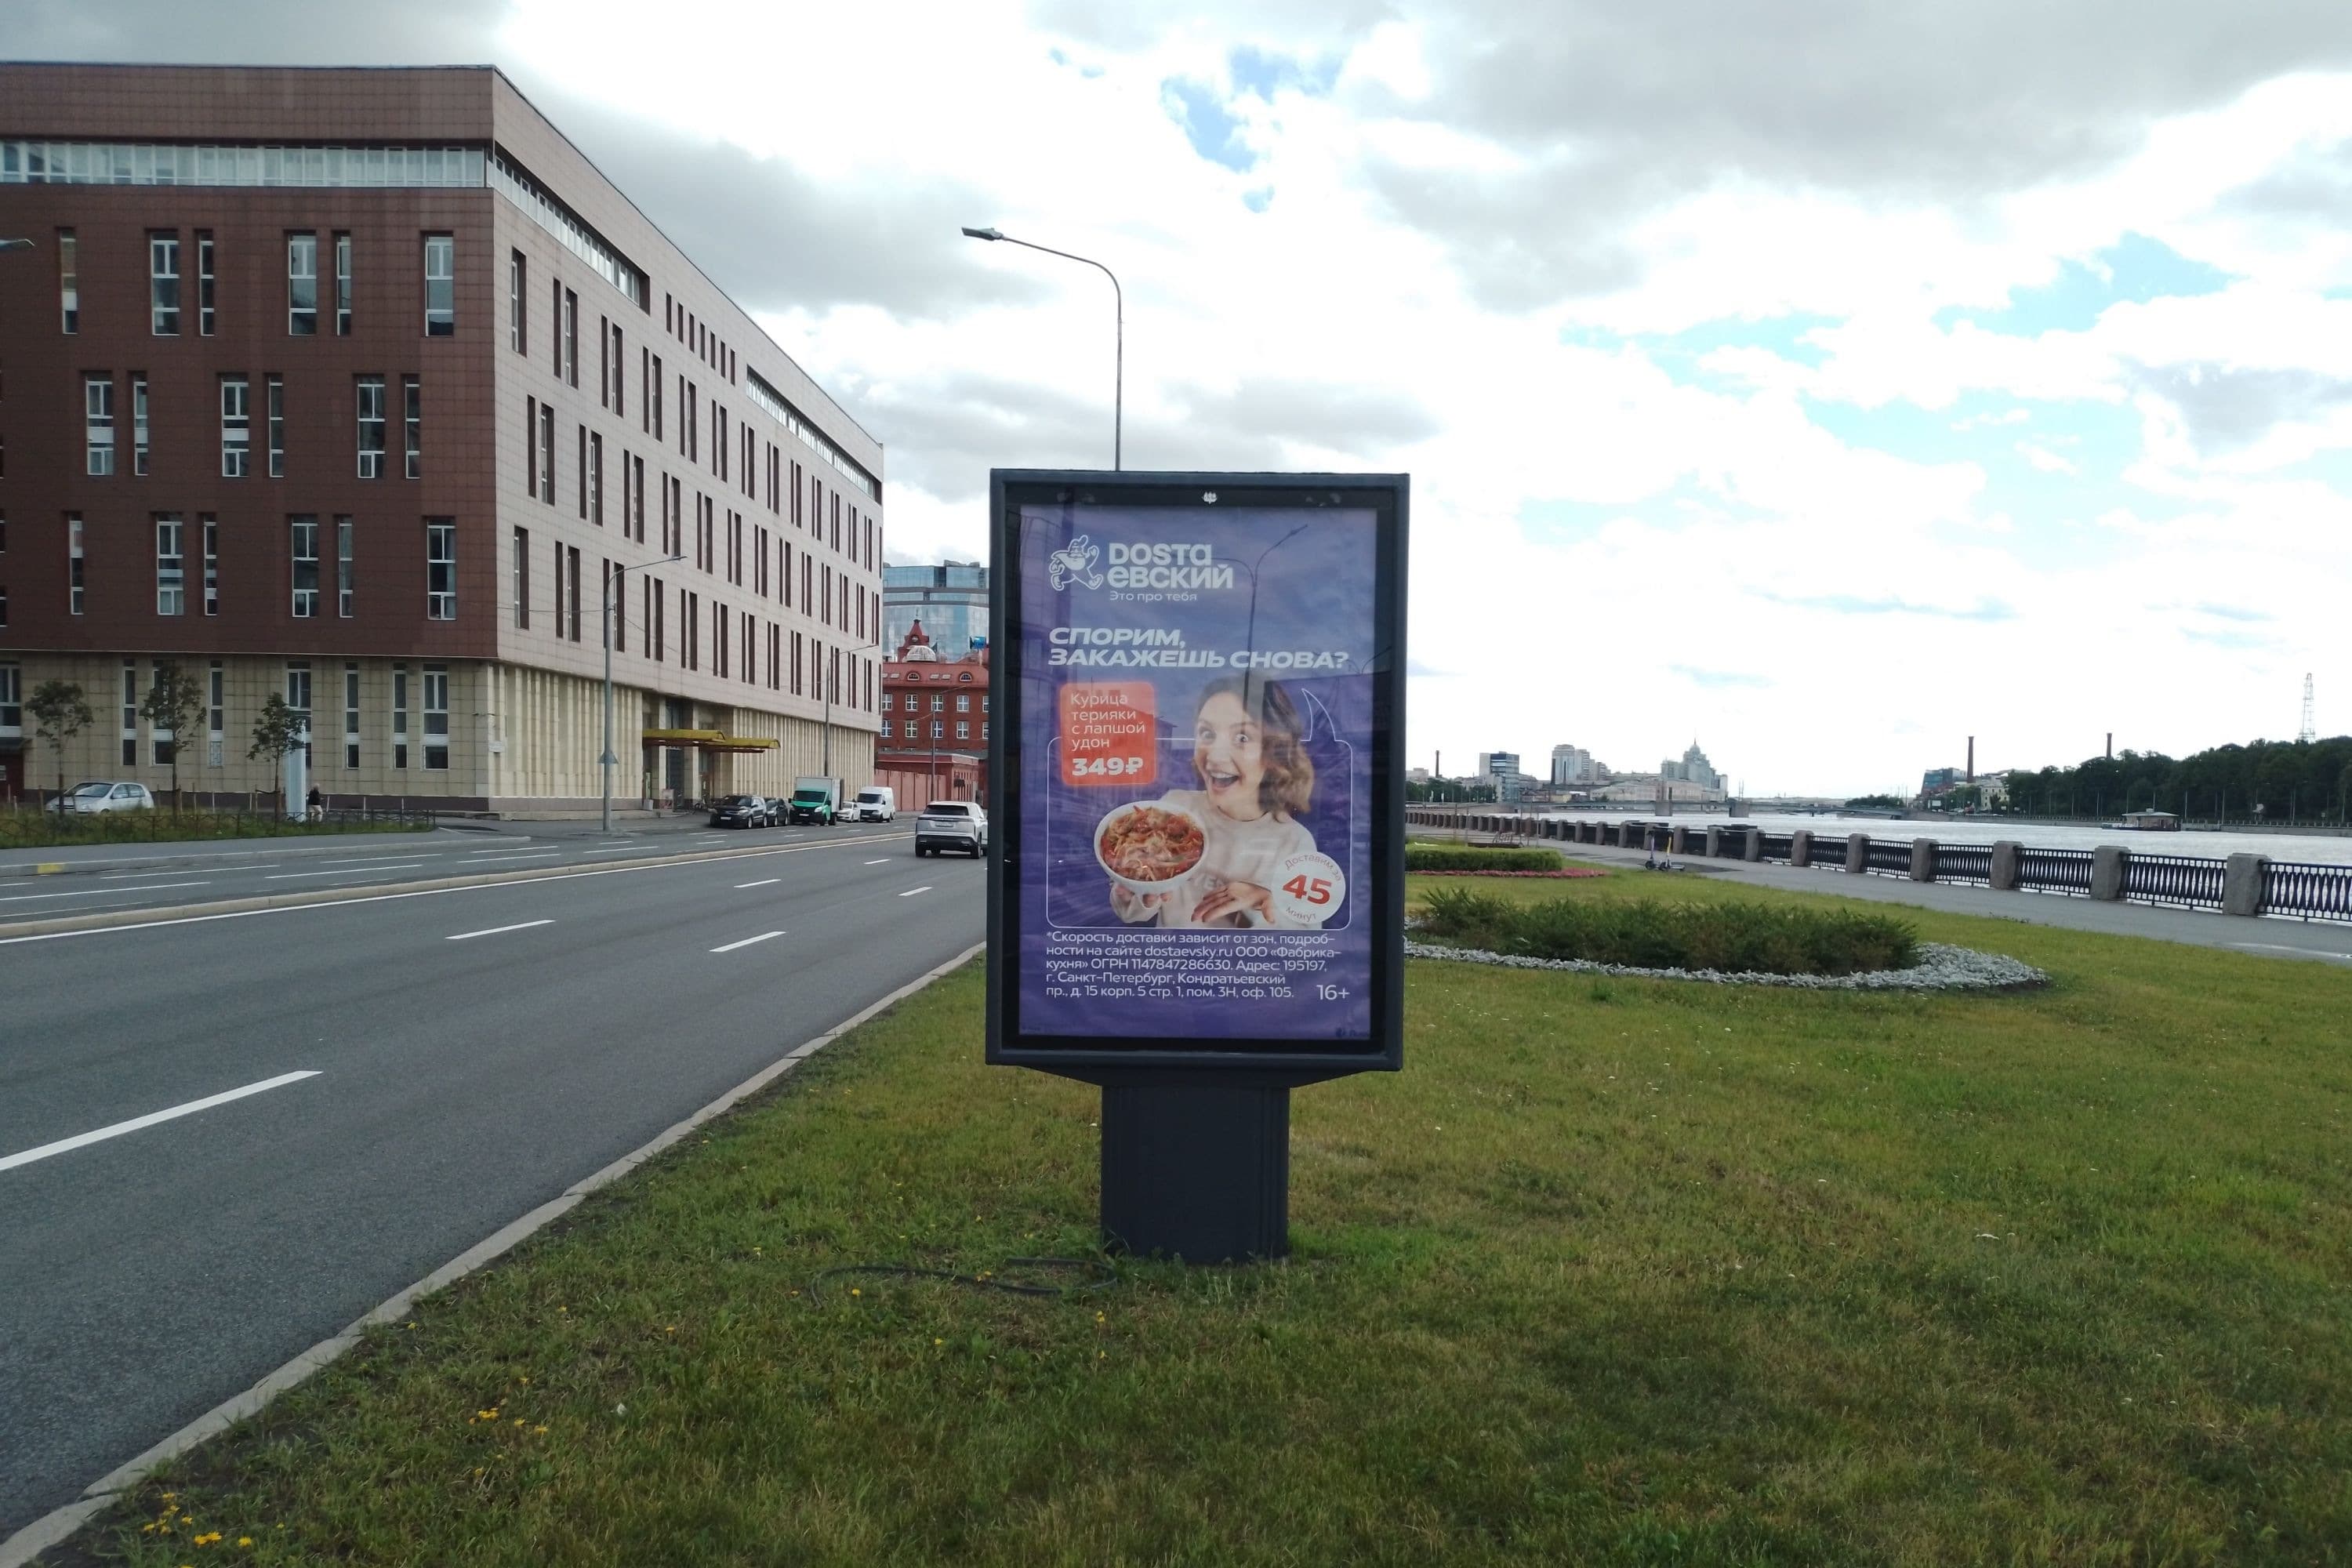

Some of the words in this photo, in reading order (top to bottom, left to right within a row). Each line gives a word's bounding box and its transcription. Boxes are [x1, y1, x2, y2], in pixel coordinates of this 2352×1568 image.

[1109, 591, 1134, 601] Это
[1137, 593, 1163, 603] про
[1167, 591, 1197, 601] тебя
[1049, 628, 1185, 648] СПОРИМ,
[1048, 648, 1225, 668] ЗАКАЖЕШЬ
[1229, 651, 1348, 670] СНОВА?
[1071, 693, 1127, 708] Курица
[1072, 710, 1136, 723] терияки
[1072, 725, 1080, 735] с
[1083, 721, 1145, 735] лапшой
[1072, 739, 1109, 752] удон
[1285, 855, 1334, 871] Доставим
[1283, 874, 1331, 905] 45
[1116, 934, 1176, 944] доставки
[1178, 935, 1231, 943] зависит
[1233, 935, 1247, 943] от
[1279, 933, 1335, 946] подроб-
[1047, 947, 1083, 956] ности
[1087, 947, 1102, 956] на
[1105, 946, 1142, 956] сайте
[1145, 946, 1233, 959] dostaevsky.ru
[1236, 946, 1268, 956] ООО
[1270, 947, 1341, 960] «Фабрика-
[1046, 960, 1088, 971] кухня»
[1091, 958, 1128, 969] ОГРН
[1131, 959, 1233, 971] 1147847286630.
[1236, 960, 1280, 973] Адрес:
[1283, 960, 1327, 971] 195197,
[1058, 971, 1175, 985] Санкт-Петербург,
[1178, 973, 1286, 986] Кондратьевский
[1047, 987, 1068, 998] пр.,
[1070, 988, 1081, 997] д.
[1084, 985, 1098, 996] 15
[1101, 988, 1134, 999] корп.
[1138, 986, 1146, 996] 5
[1149, 988, 1174, 1000] стр.
[1175, 986, 1184, 998] 1,
[1186, 988, 1215, 997] пом.
[1218, 986, 1239, 998] 3Н,
[1241, 986, 1267, 1000] оф.
[1269, 987, 1294, 998] 105.
[1316, 985, 1350, 1000] 16+
